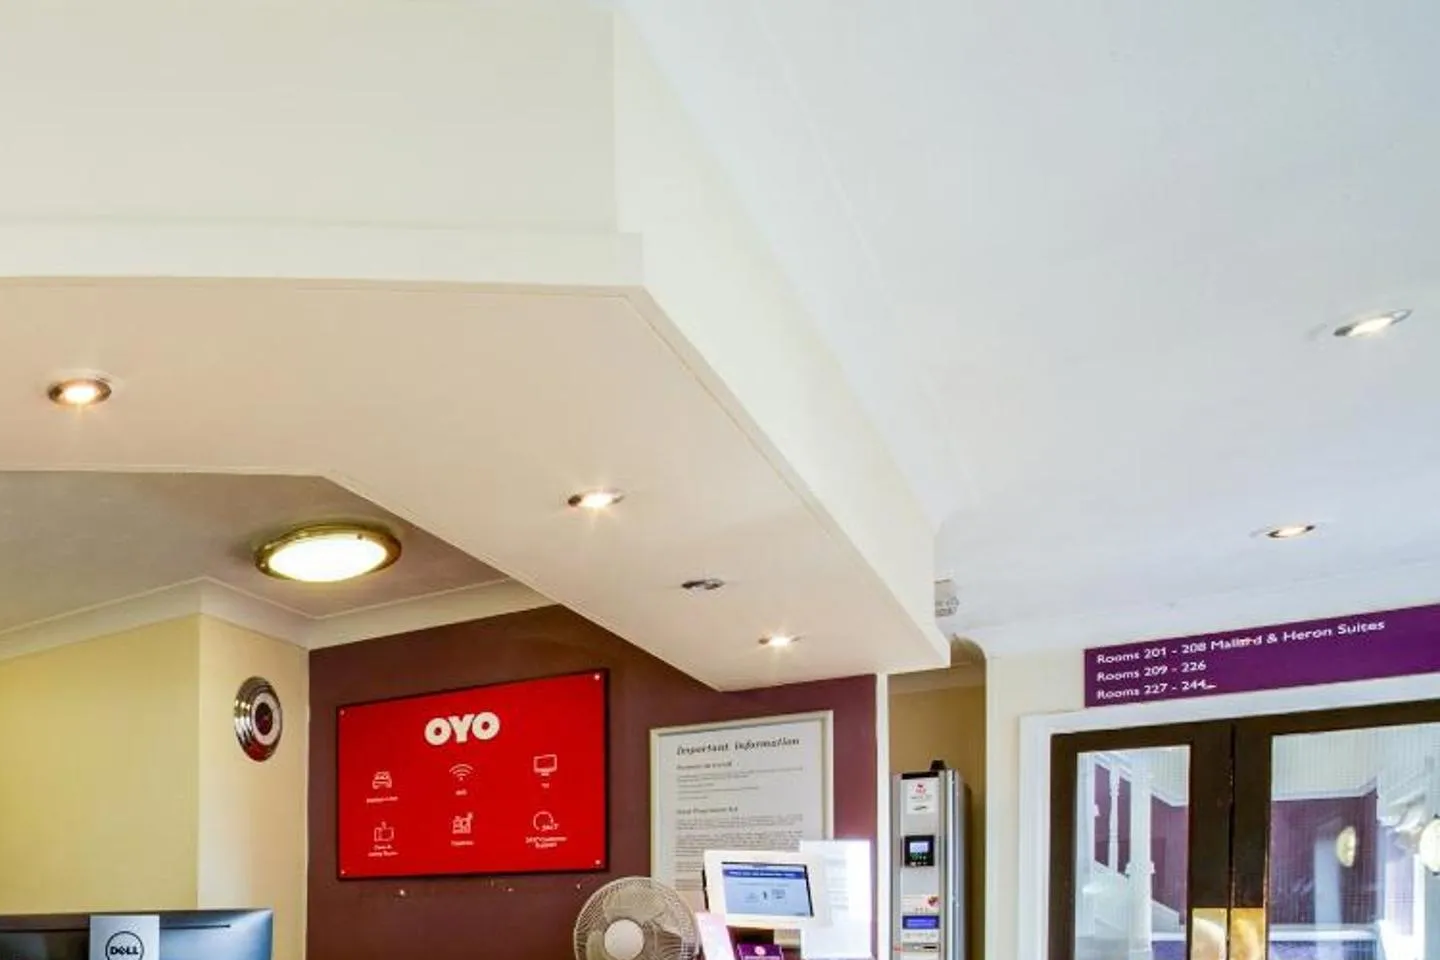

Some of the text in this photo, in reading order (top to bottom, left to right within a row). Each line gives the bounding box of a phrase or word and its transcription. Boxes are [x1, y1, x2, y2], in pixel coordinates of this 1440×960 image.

[1096, 652, 1140, 664] Rooms
[1144, 647, 1167, 660] 201
[1181, 642, 1207, 655] 208
[1266, 632, 1278, 644] &
[1283, 628, 1333, 642] Heron
[1337, 621, 1386, 635] Suites
[1096, 670, 1140, 682] Rooms
[1144, 665, 1169, 677] 209
[1181, 660, 1207, 673] 226
[1096, 688, 1140, 700] Rooms
[1144, 683, 1169, 695] 227
[424, 711, 501, 746] OYO
[110, 946, 139, 955] DELL
